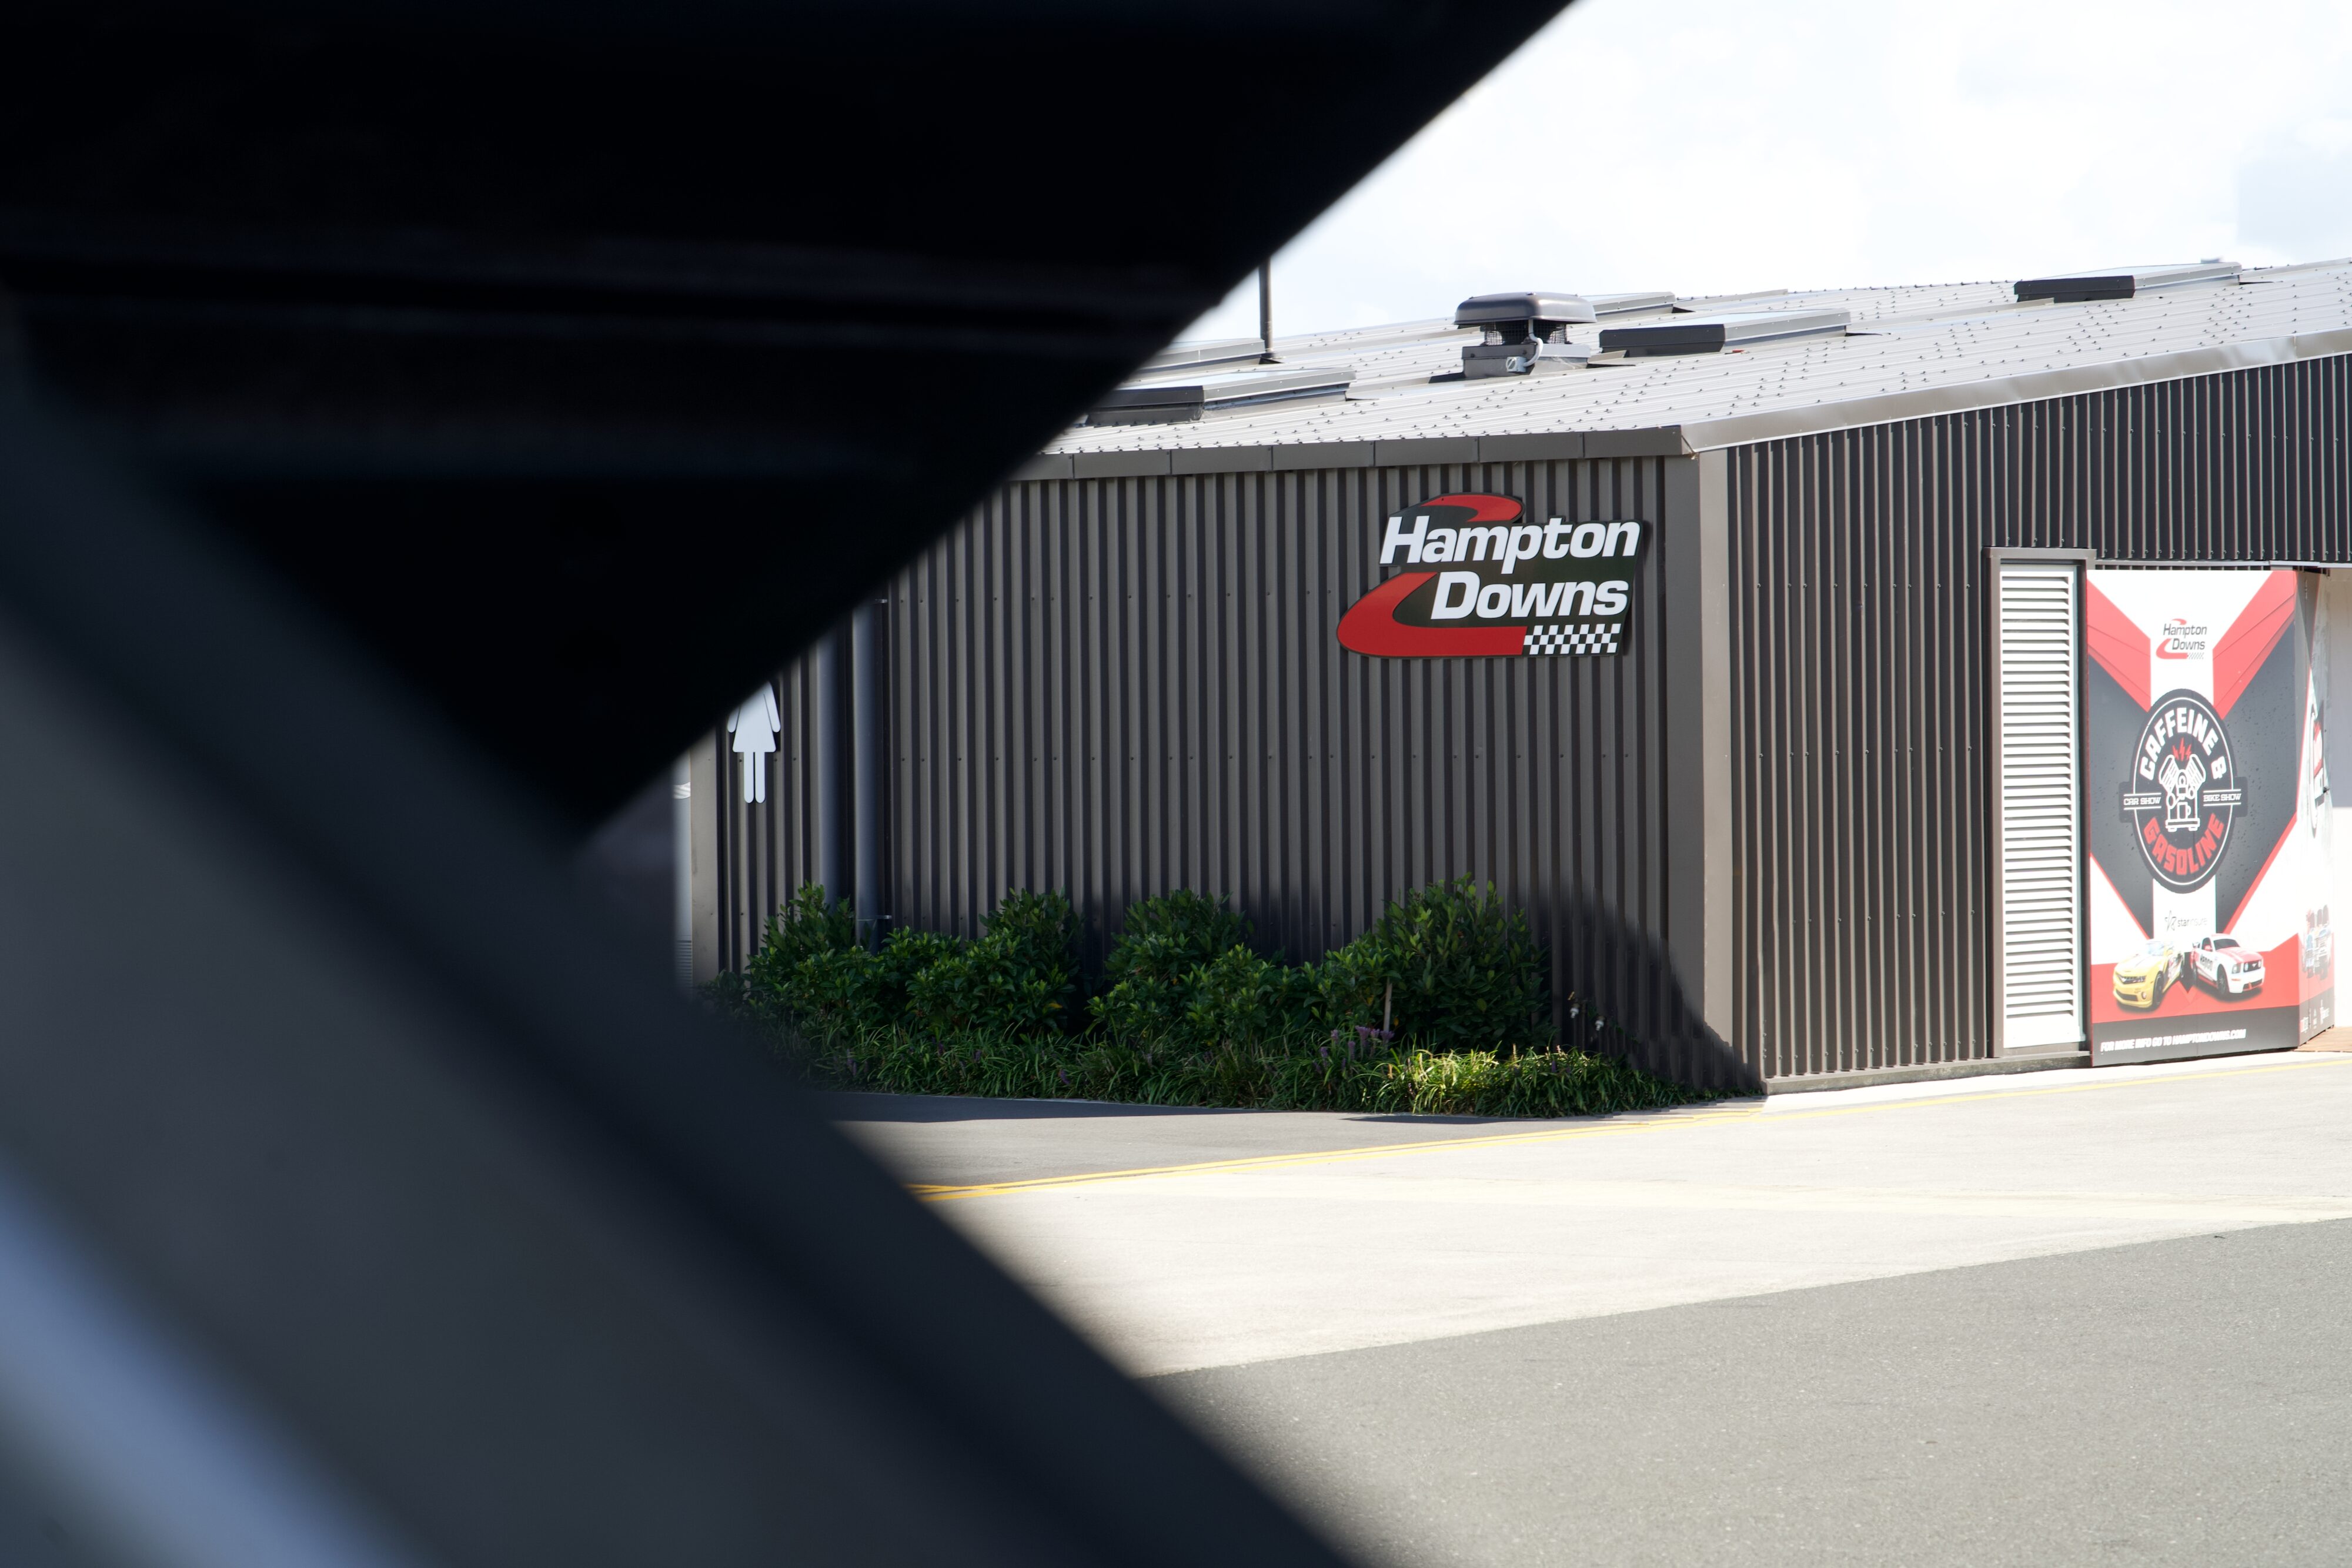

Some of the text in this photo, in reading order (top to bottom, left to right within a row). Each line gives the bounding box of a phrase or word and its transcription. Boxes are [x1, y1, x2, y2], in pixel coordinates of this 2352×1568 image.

[1379, 515, 1641, 574] Hampton
[1430, 571, 1629, 620] Downs
[2163, 623, 2207, 638] Hampton
[2172, 638, 2206, 650] Downs
[2140, 707, 2219, 780] CAFFEINE
[2140, 797, 2161, 805] SHOW
[2221, 793, 2241, 801] SHOW
[2144, 813, 2224, 875] GASOLINE
[2100, 1042, 2114, 1052] FOR
[2114, 1039, 2135, 1050] MORE
[2135, 1038, 2151, 1048] INFO
[2152, 1037, 2163, 1047] GO
[2163, 1036, 2172, 1046] TO
